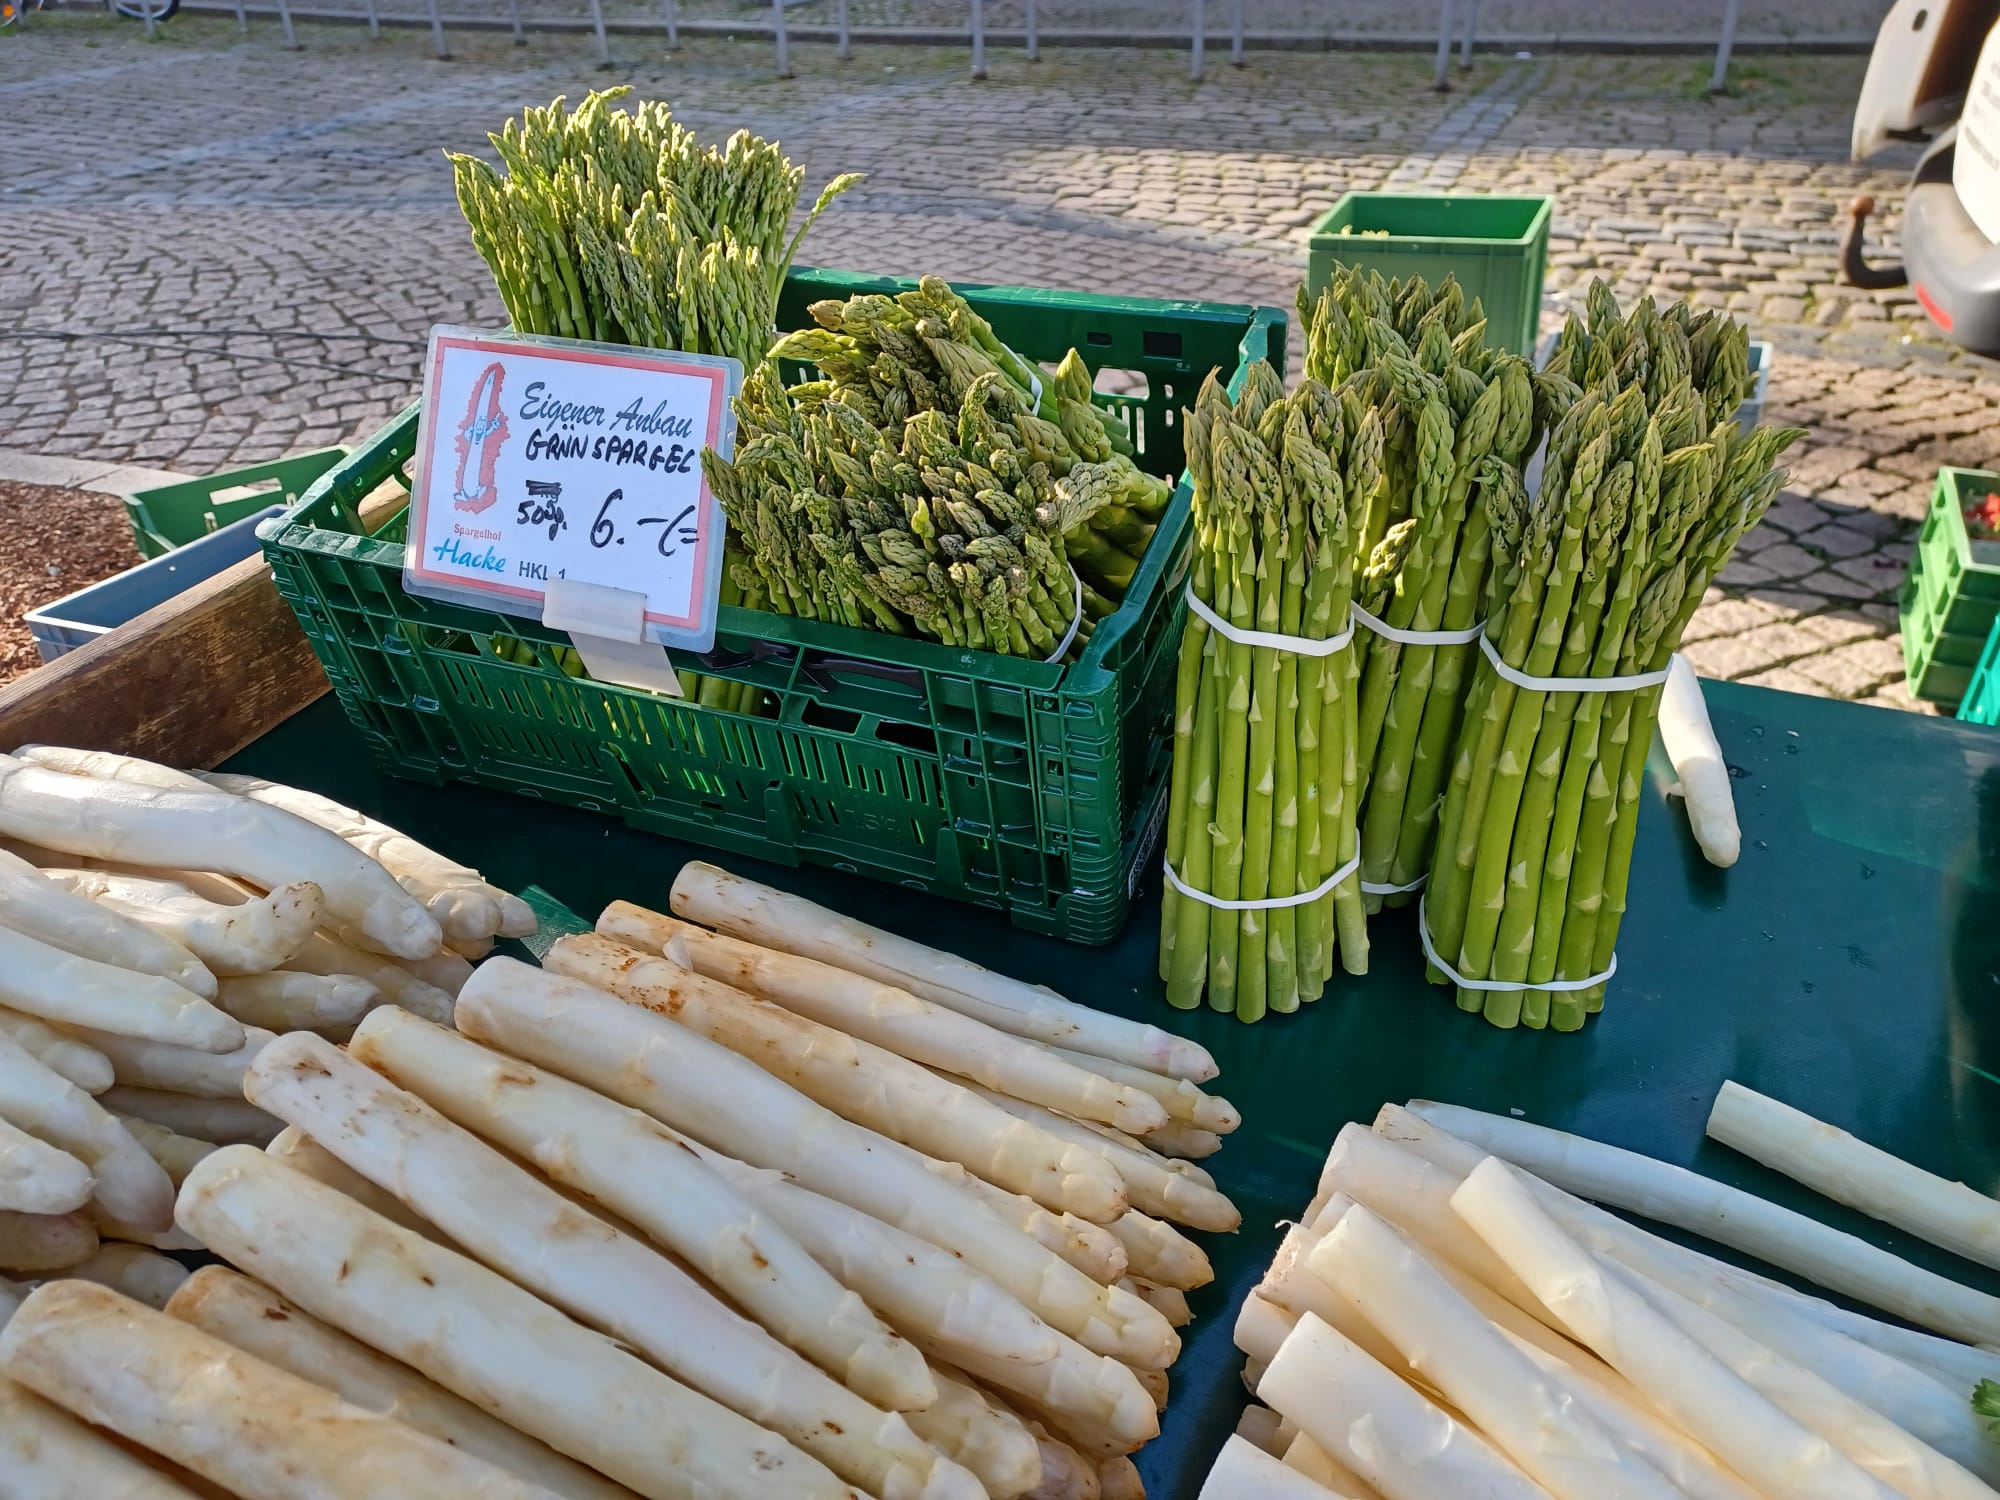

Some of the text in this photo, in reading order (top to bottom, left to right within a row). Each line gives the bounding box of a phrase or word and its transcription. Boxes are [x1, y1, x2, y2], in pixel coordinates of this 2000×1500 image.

[520, 381, 693, 438] Eigener Anbau
[454, 523, 503, 542] Spargelhof
[433, 538, 507, 573] Hacke
[519, 561, 548, 581] HKL
